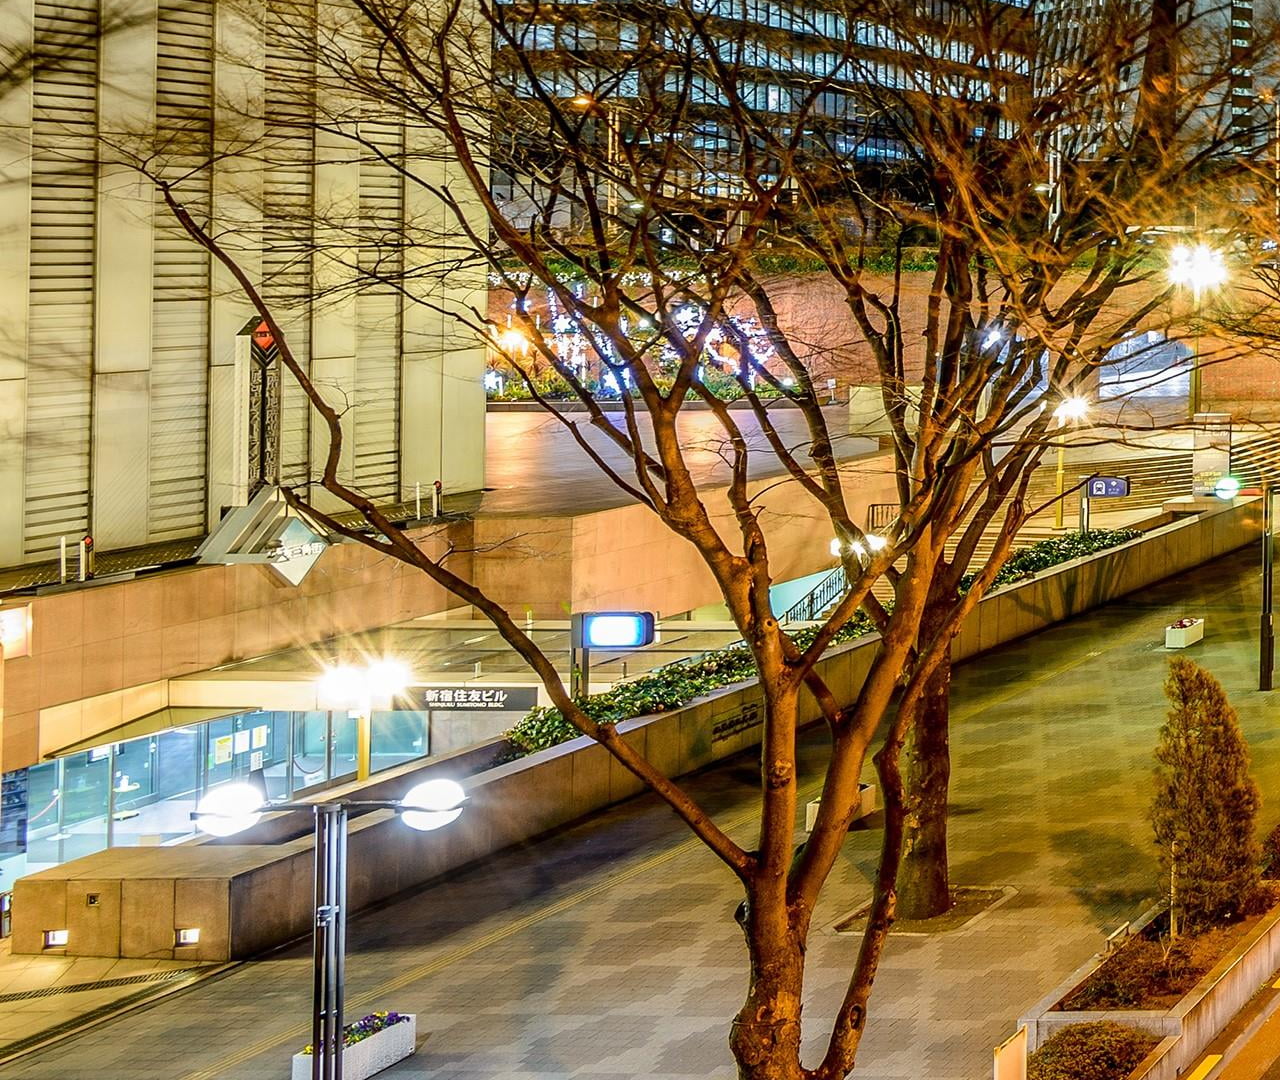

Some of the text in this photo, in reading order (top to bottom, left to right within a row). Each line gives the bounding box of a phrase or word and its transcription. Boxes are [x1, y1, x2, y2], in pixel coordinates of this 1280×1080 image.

[425, 689, 508, 702] 新宿住友ビル
